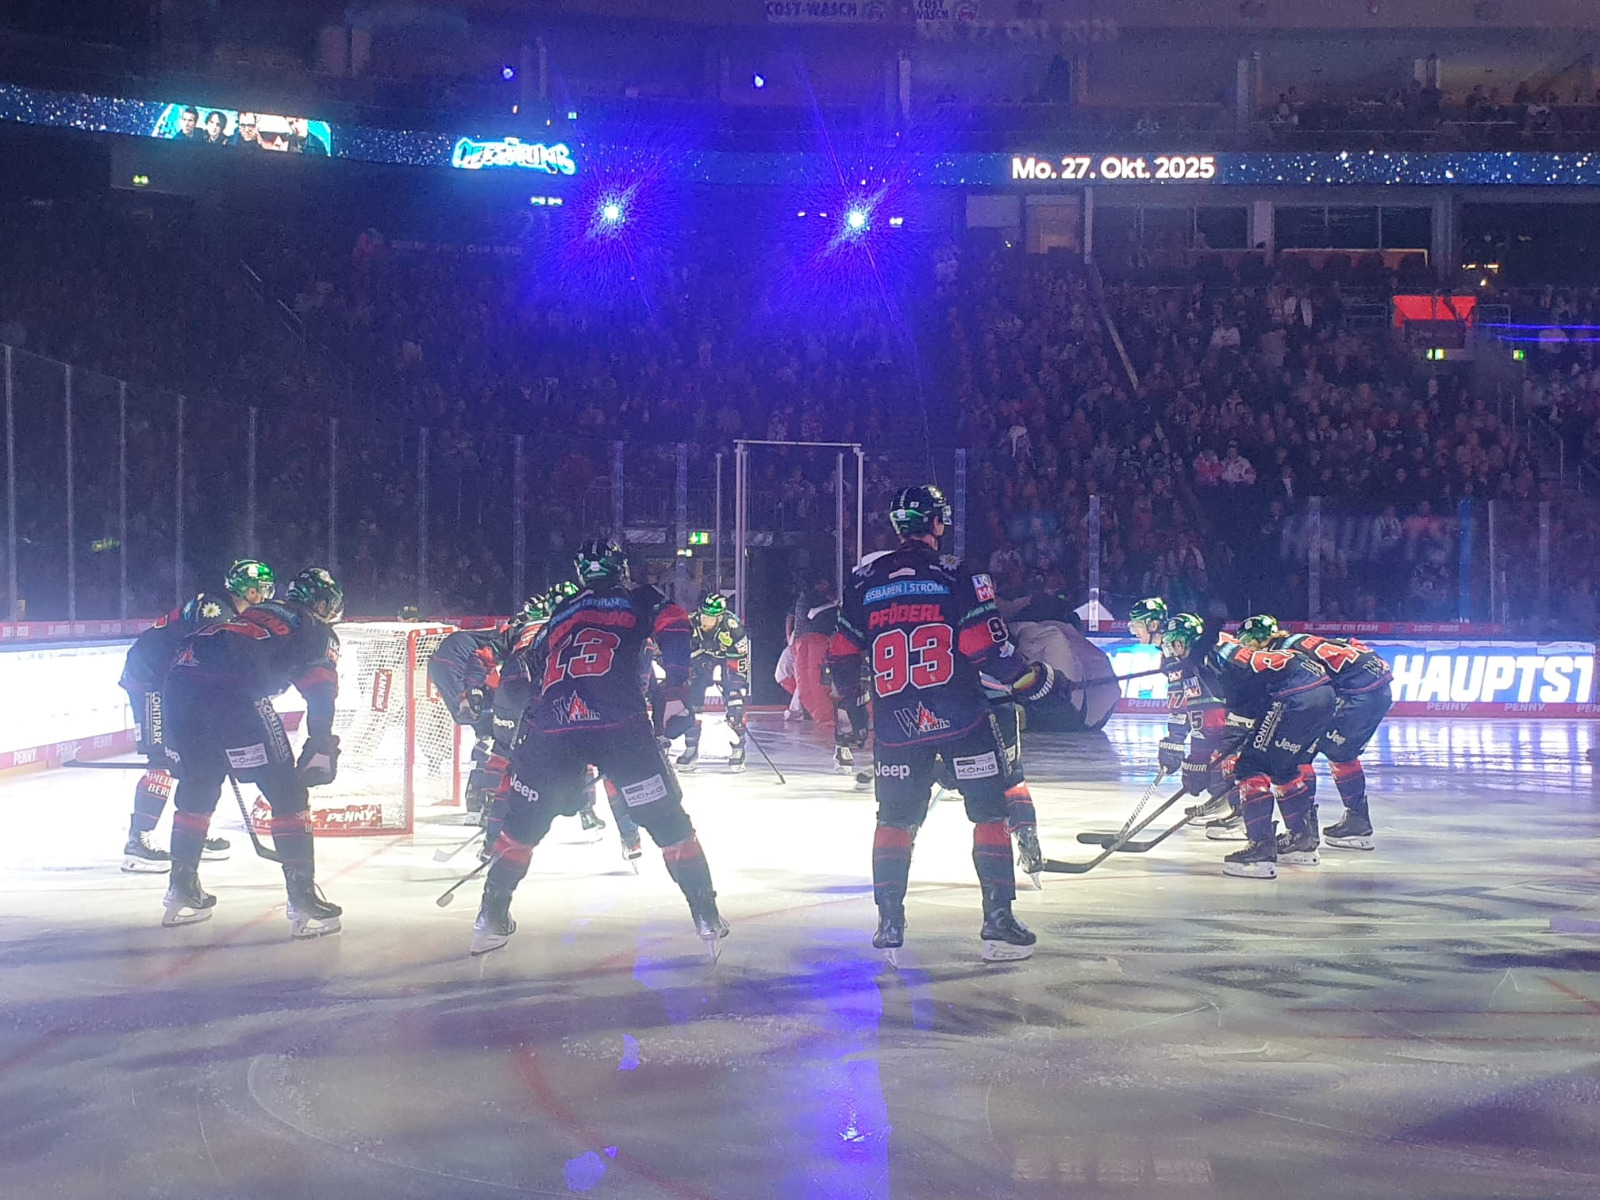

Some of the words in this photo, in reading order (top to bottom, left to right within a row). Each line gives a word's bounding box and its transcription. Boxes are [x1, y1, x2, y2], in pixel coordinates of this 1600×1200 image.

[1012, 157, 1057, 179] Mo.
[1061, 157, 1096, 179] 27.
[1101, 157, 1150, 179] Okt.
[1154, 156, 1215, 179] 2025
[909, 583, 944, 593] STROM
[869, 602, 944, 629] PFÖDERL
[872, 623, 954, 698] 93
[151, 691, 162, 744] CONTIPARK
[1275, 737, 1302, 754] Jeep
[875, 761, 911, 779] Jeep
[957, 764, 996, 774] KÖNIG
[510, 774, 539, 802] Jeep
